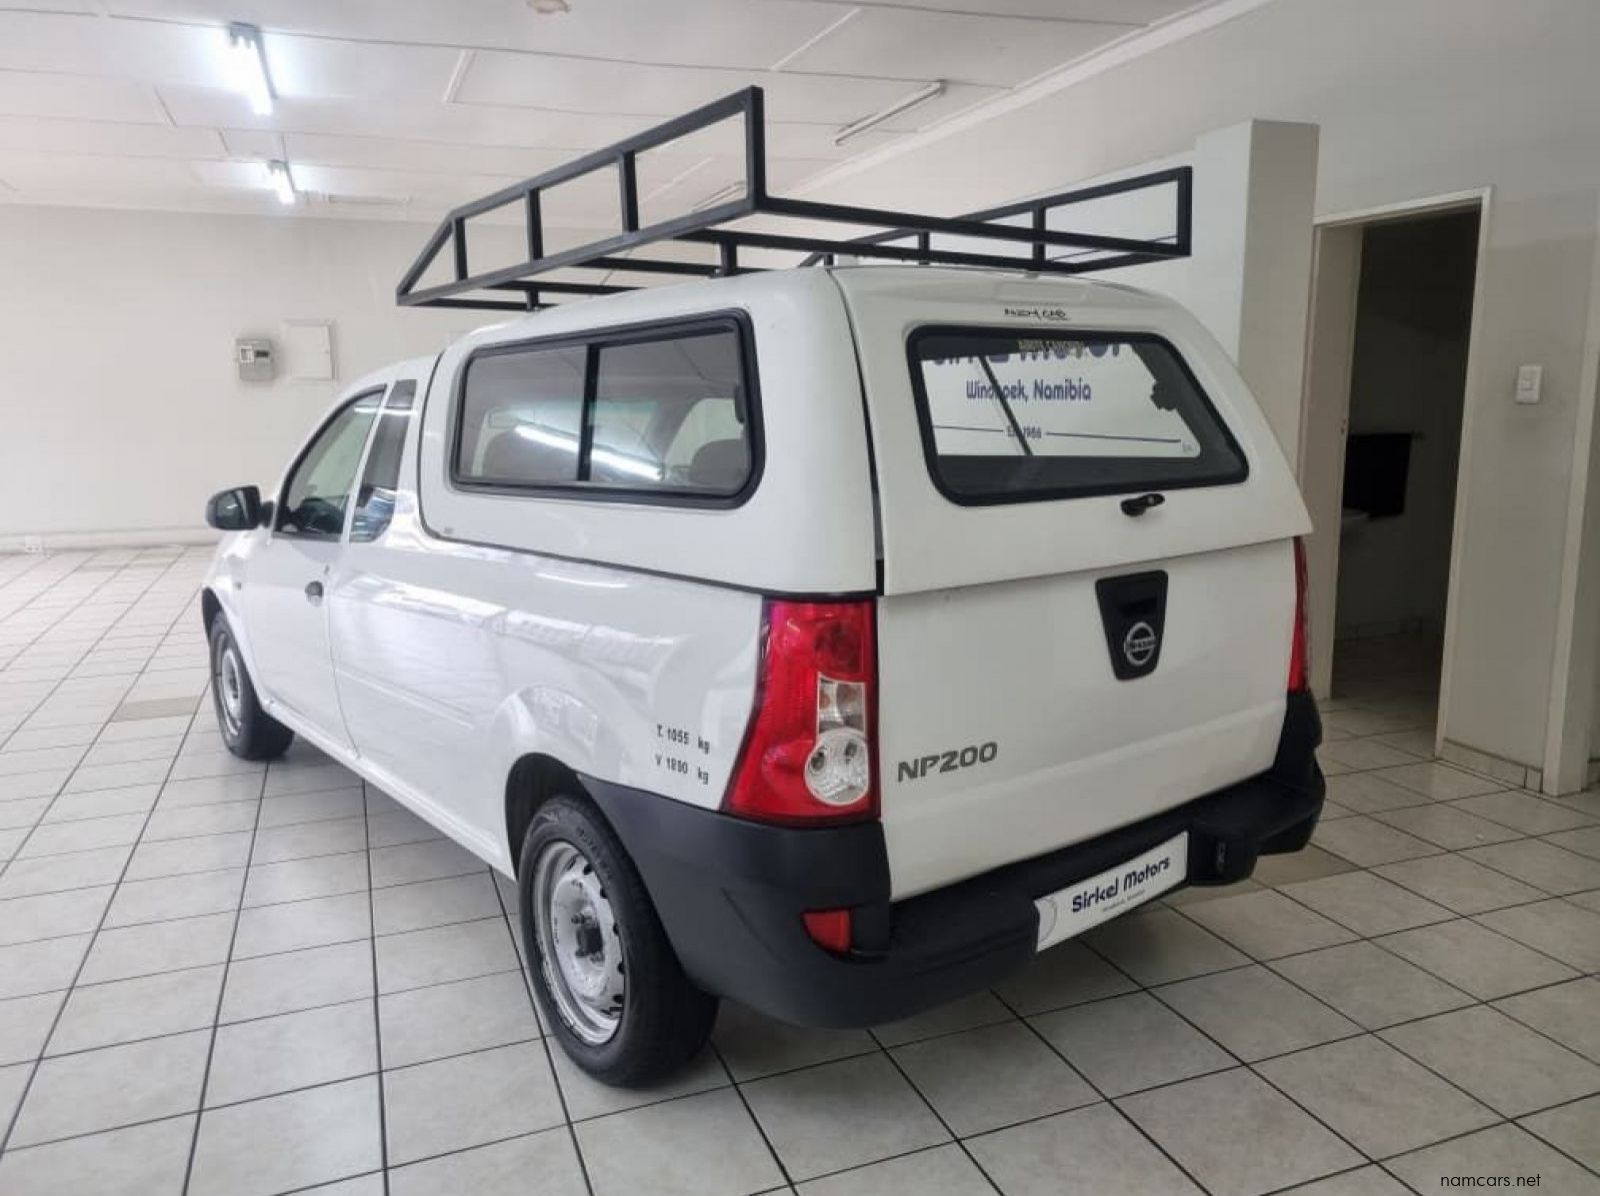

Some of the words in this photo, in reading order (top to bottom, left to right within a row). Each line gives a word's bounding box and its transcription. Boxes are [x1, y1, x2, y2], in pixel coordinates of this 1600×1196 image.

[1034, 377, 1091, 401] Namibia
[698, 766, 709, 785] kg
[898, 741, 998, 782] NP200
[1072, 876, 1119, 913] Sirkel
[1123, 856, 1171, 892] Motors
